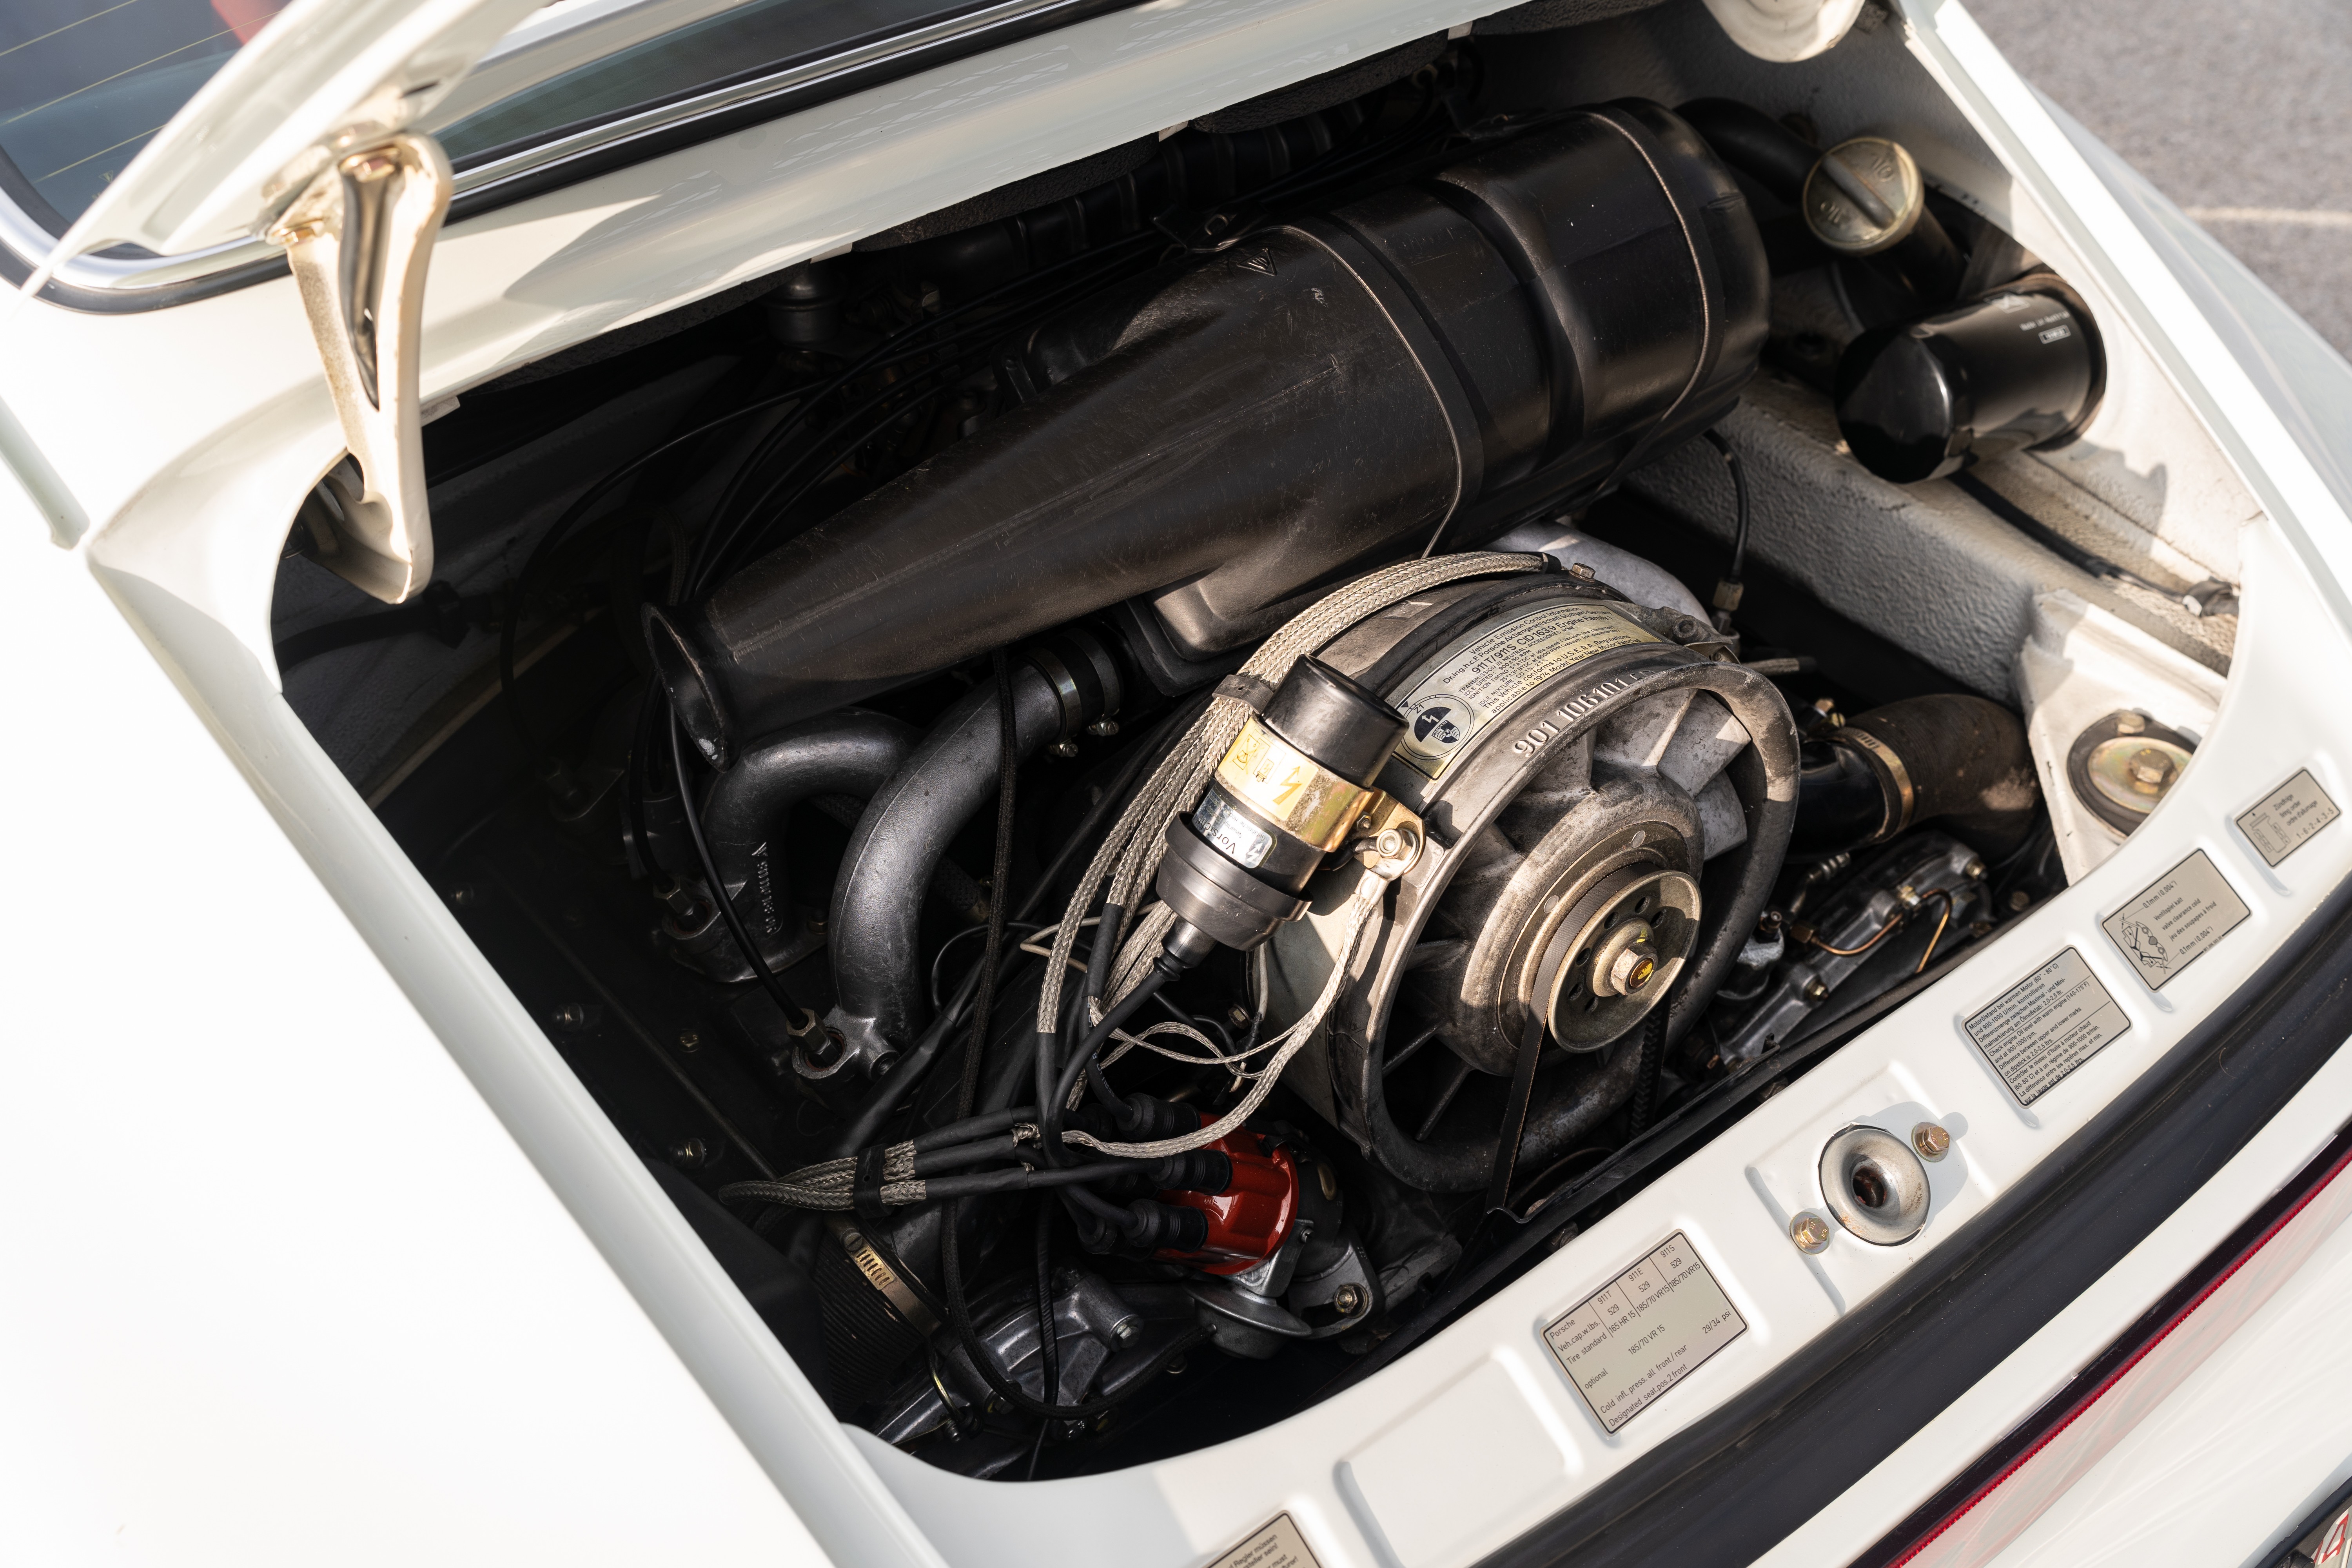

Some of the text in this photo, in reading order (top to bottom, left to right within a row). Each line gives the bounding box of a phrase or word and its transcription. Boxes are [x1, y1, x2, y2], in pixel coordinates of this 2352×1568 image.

[1469, 608, 1581, 655] Vehicle Emission Control Information
[1478, 640, 1506, 657] Porsche
[1504, 616, 1562, 642] Aktiengesellschaft
[1517, 635, 1534, 645] CID
[1532, 626, 1556, 637] 163,9
[1555, 616, 1584, 628] Engine
[1459, 666, 1496, 693] TRANSMISSION
[1528, 631, 1561, 647] ACCESSORIES
[1483, 697, 1499, 709] This
[1497, 681, 1523, 698] Vehicle
[1523, 662, 1554, 681] conforms
[1593, 635, 1630, 645] Regulations
[1517, 662, 1532, 671] BTDC
[1464, 686, 1476, 697] IDLE
[1469, 682, 1491, 699] IGNITION
[1516, 657, 1530, 666] ATDC
[1491, 686, 1527, 713] applicable
[1534, 672, 1550, 682] 1974
[1549, 661, 1571, 673] Model
[1569, 653, 1584, 662] Year
[1479, 696, 1492, 706] IDLE
[1432, 720, 1448, 737] PORSCHE
[1974, 983, 2045, 1037] und 900-1000 U/min. kontrollieren
[1996, 1001, 2005, 1010] bei
[2004, 991, 2022, 1005] warmen
[2020, 981, 2034, 993] Motor
[1978, 984, 2056, 1043] Differenzmenge zwischen Maximal und
[1989, 1045, 2004, 1057] Check
[2003, 1035, 2018, 1047] engine
[2022, 1022, 2034, 1033] level
[2033, 1016, 2043, 1025] with
[2041, 1008, 2054, 1018] warm
[2053, 998, 2067, 1010] engine
[1984, 1026, 2015, 1050] malmarkierung
[1994, 1054, 2004, 1064] and
[2007, 1036, 2027, 1054] 900-1000
[2025, 1031, 2037, 1040] rpm.
[1998, 1007, 2082, 1070] Difference between upper and lower marks
[2033, 1054, 2047, 1067] niveau
[2063, 1030, 2079, 1044] moteur
[2078, 1020, 2092, 1033] chaud
[2067, 1033, 2087, 1050] 900-1000
[2086, 1025, 2100, 1036] tr/min.
[2010, 1058, 2027, 1072] dipstick
[2025, 1076, 2046, 1093] difference
[2045, 1067, 2057, 1078] entre
[2078, 1043, 2089, 1053] max.
[2092, 1033, 2103, 1042] min.
[1670, 1257, 1682, 1269] 529
[1638, 1281, 1651, 1293] 529
[1607, 1303, 1620, 1316] 529
[1636, 1295, 1657, 1313] 185/70
[1549, 1319, 1576, 1340] Porsche
[1608, 1310, 1636, 1334] 165 HR 15
[1702, 1308, 1731, 1334] 29/34 psi
[1557, 1321, 1601, 1352] Veh.cap.w.lbs.
[1566, 1332, 1607, 1365] Tire standard
[1628, 1324, 1666, 1355] 185/70 VR 15
[1584, 1368, 1608, 1389] optional
[1600, 1368, 1657, 1414] Cold infl. press. all
[1608, 1397, 1642, 1426] Designated
[1671, 1363, 1688, 1378] front
[1272, 1554, 1288, 1567] must
